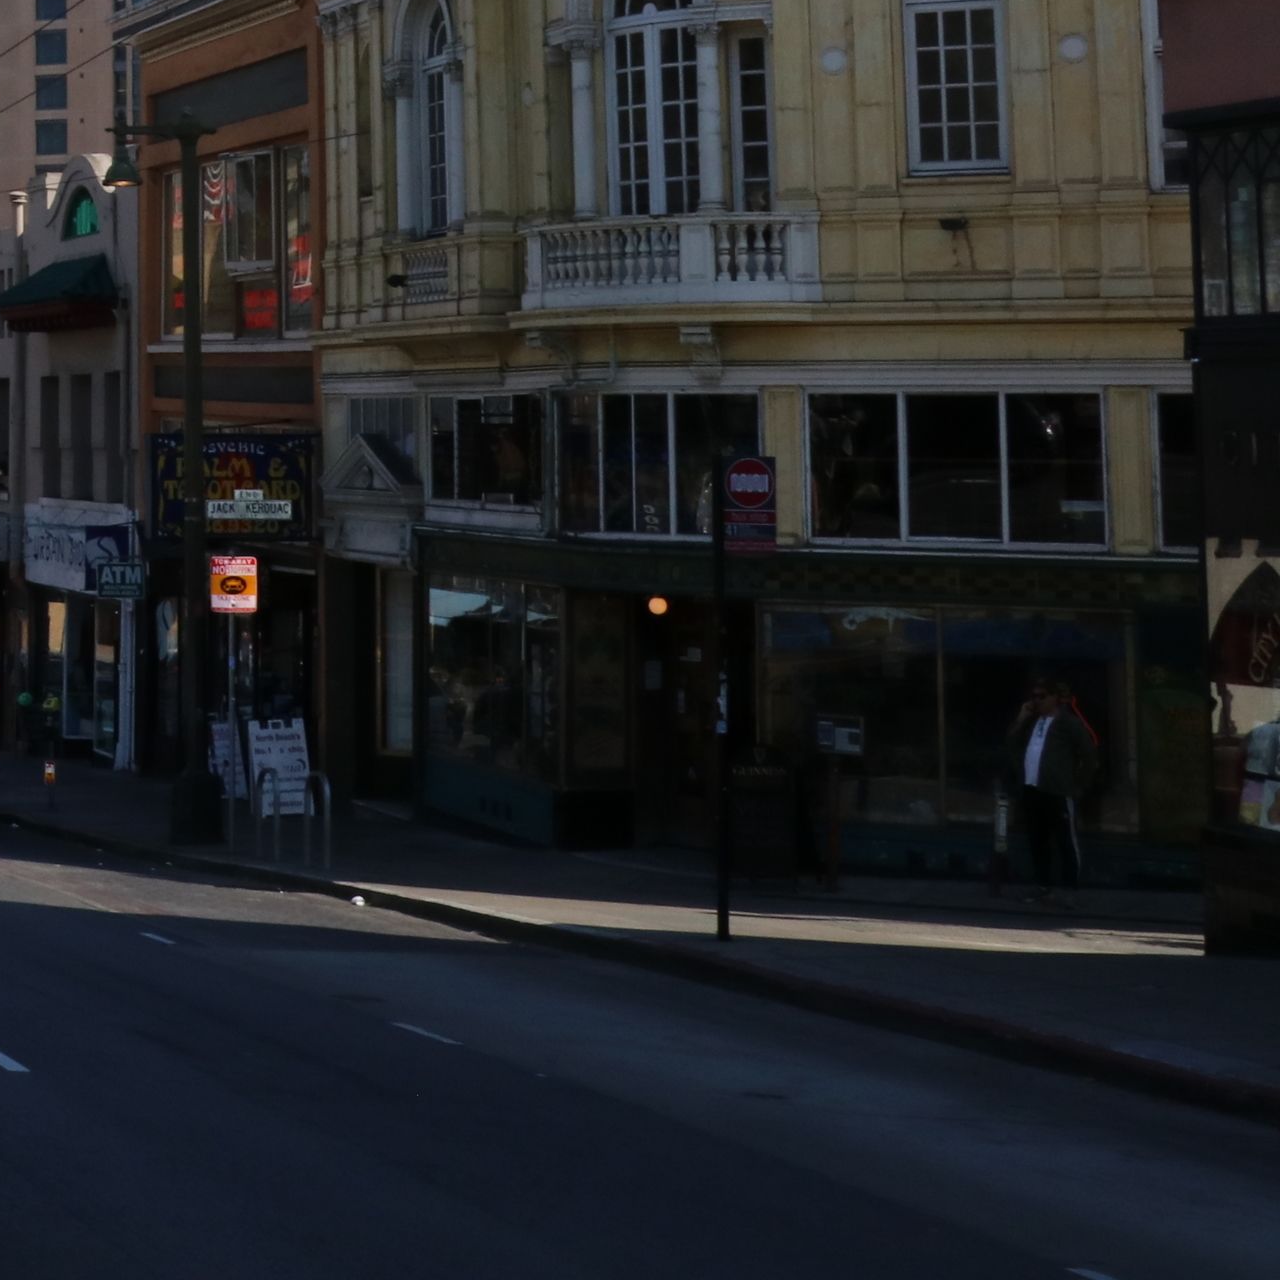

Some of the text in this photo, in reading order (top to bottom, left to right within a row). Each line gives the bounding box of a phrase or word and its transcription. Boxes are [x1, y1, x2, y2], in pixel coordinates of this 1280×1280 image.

[175, 457, 251, 479] LM
[164, 480, 234, 500] TOT
[210, 503, 289, 514] JACK KEROUAC
[100, 565, 142, 585] ATM
[212, 565, 225, 575] NO
